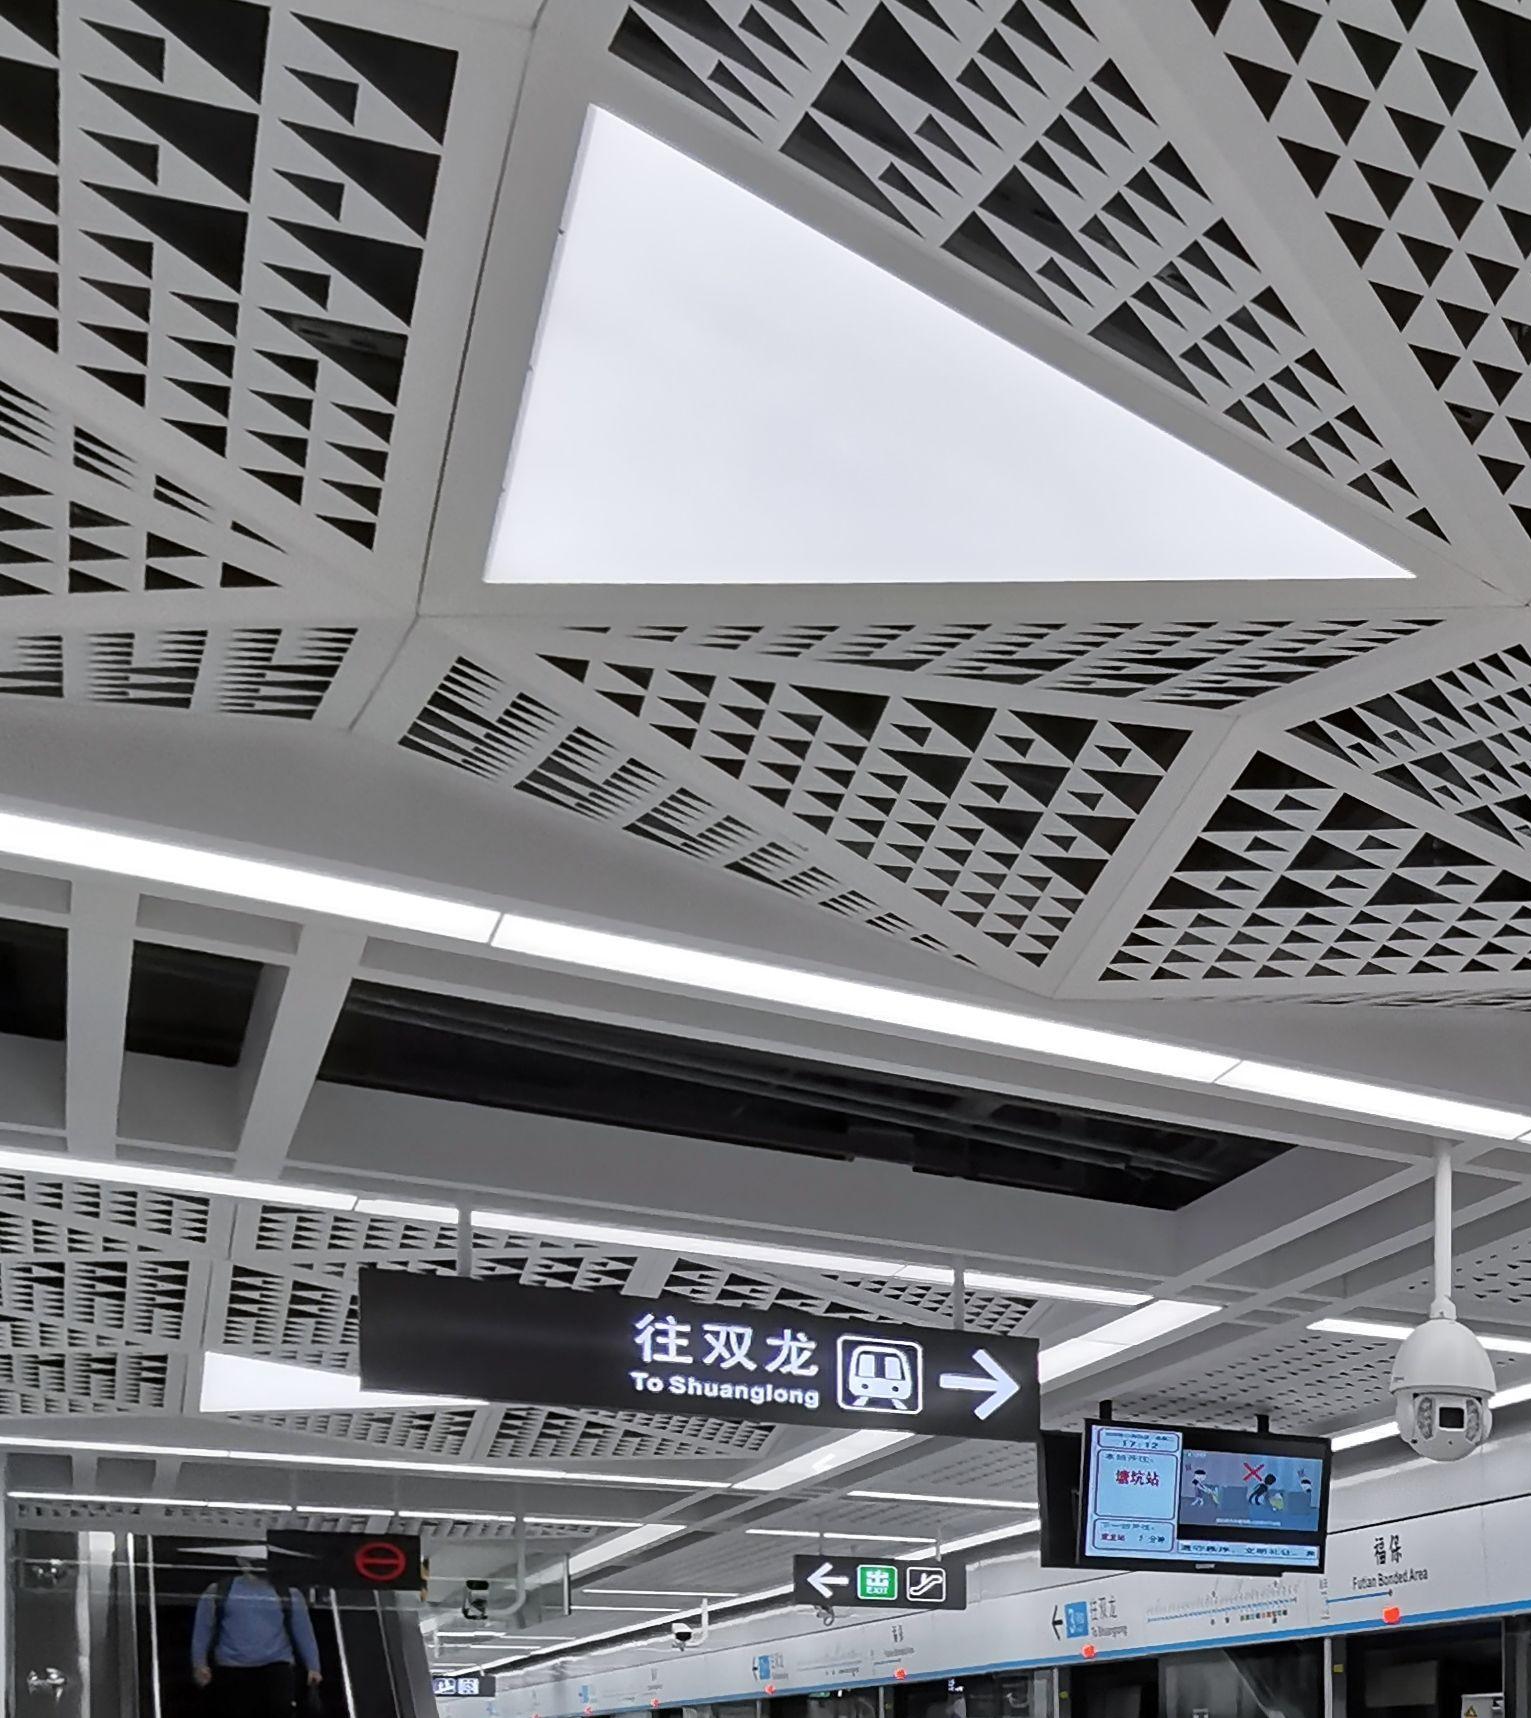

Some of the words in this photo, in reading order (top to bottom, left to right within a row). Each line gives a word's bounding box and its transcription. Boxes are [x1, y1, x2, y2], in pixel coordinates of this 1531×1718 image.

[634, 1313, 820, 1377] 往双龙
[629, 1371, 665, 1393] To
[668, 1375, 821, 1409] Shuanglong
